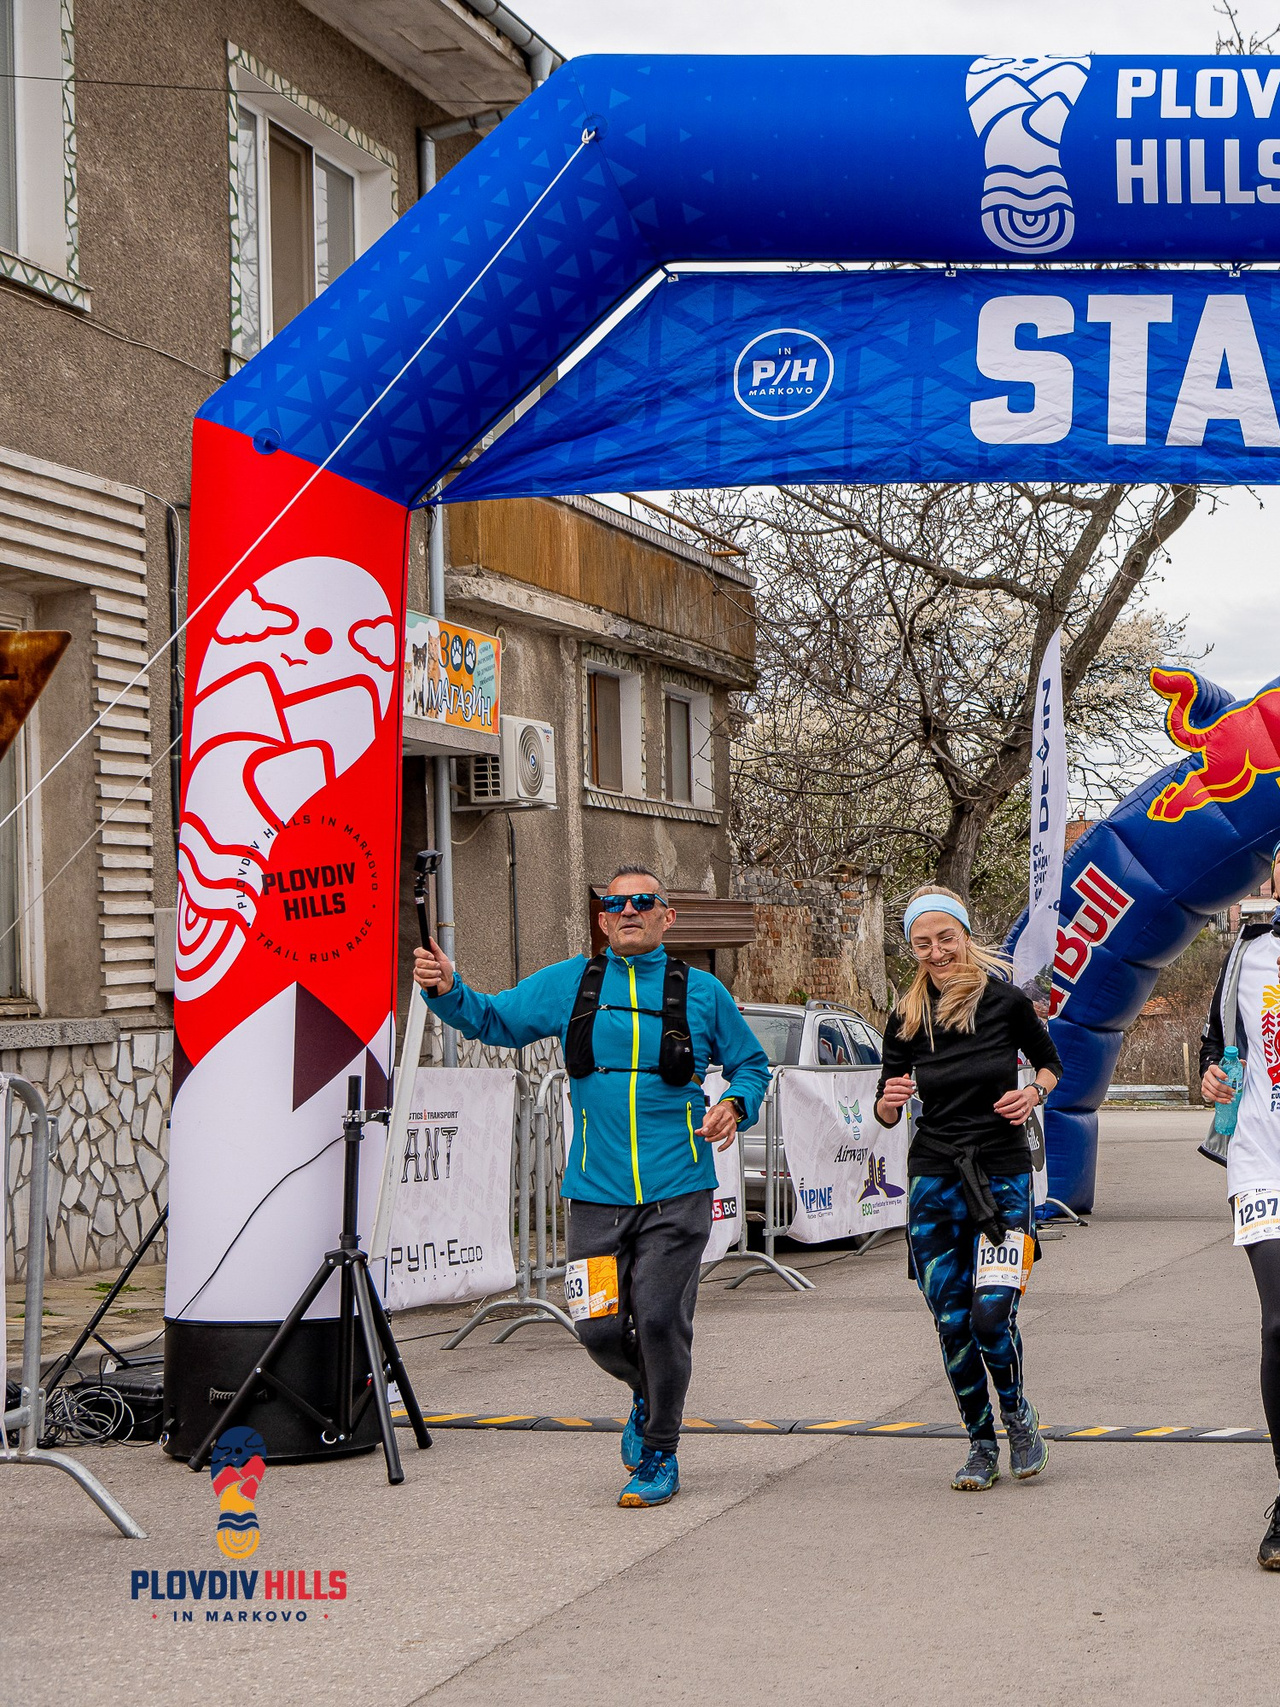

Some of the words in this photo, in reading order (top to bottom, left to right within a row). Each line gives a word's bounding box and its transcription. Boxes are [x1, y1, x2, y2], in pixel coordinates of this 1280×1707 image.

[778, 347, 792, 355] IN
[751, 358, 818, 387] P/H
[748, 387, 813, 396] MARKOVO
[428, 677, 492, 727] МАГАЗИН
[236, 840, 260, 910] PLOVDIV
[263, 814, 311, 839] HILLS
[321, 815, 337, 828] IN
[343, 824, 378, 891] MARKOVO
[261, 862, 356, 896] PLOVDIV
[283, 892, 346, 921] HILLS
[1055, 862, 1135, 986] Bull
[256, 932, 299, 962] TRAIL
[309, 949, 340, 963] RUN
[346, 919, 373, 951] RACE
[427, 1110, 458, 1119] TRANSPORT
[1238, 1197, 1279, 1227] 1297
[980, 1246, 1019, 1266] 1300
